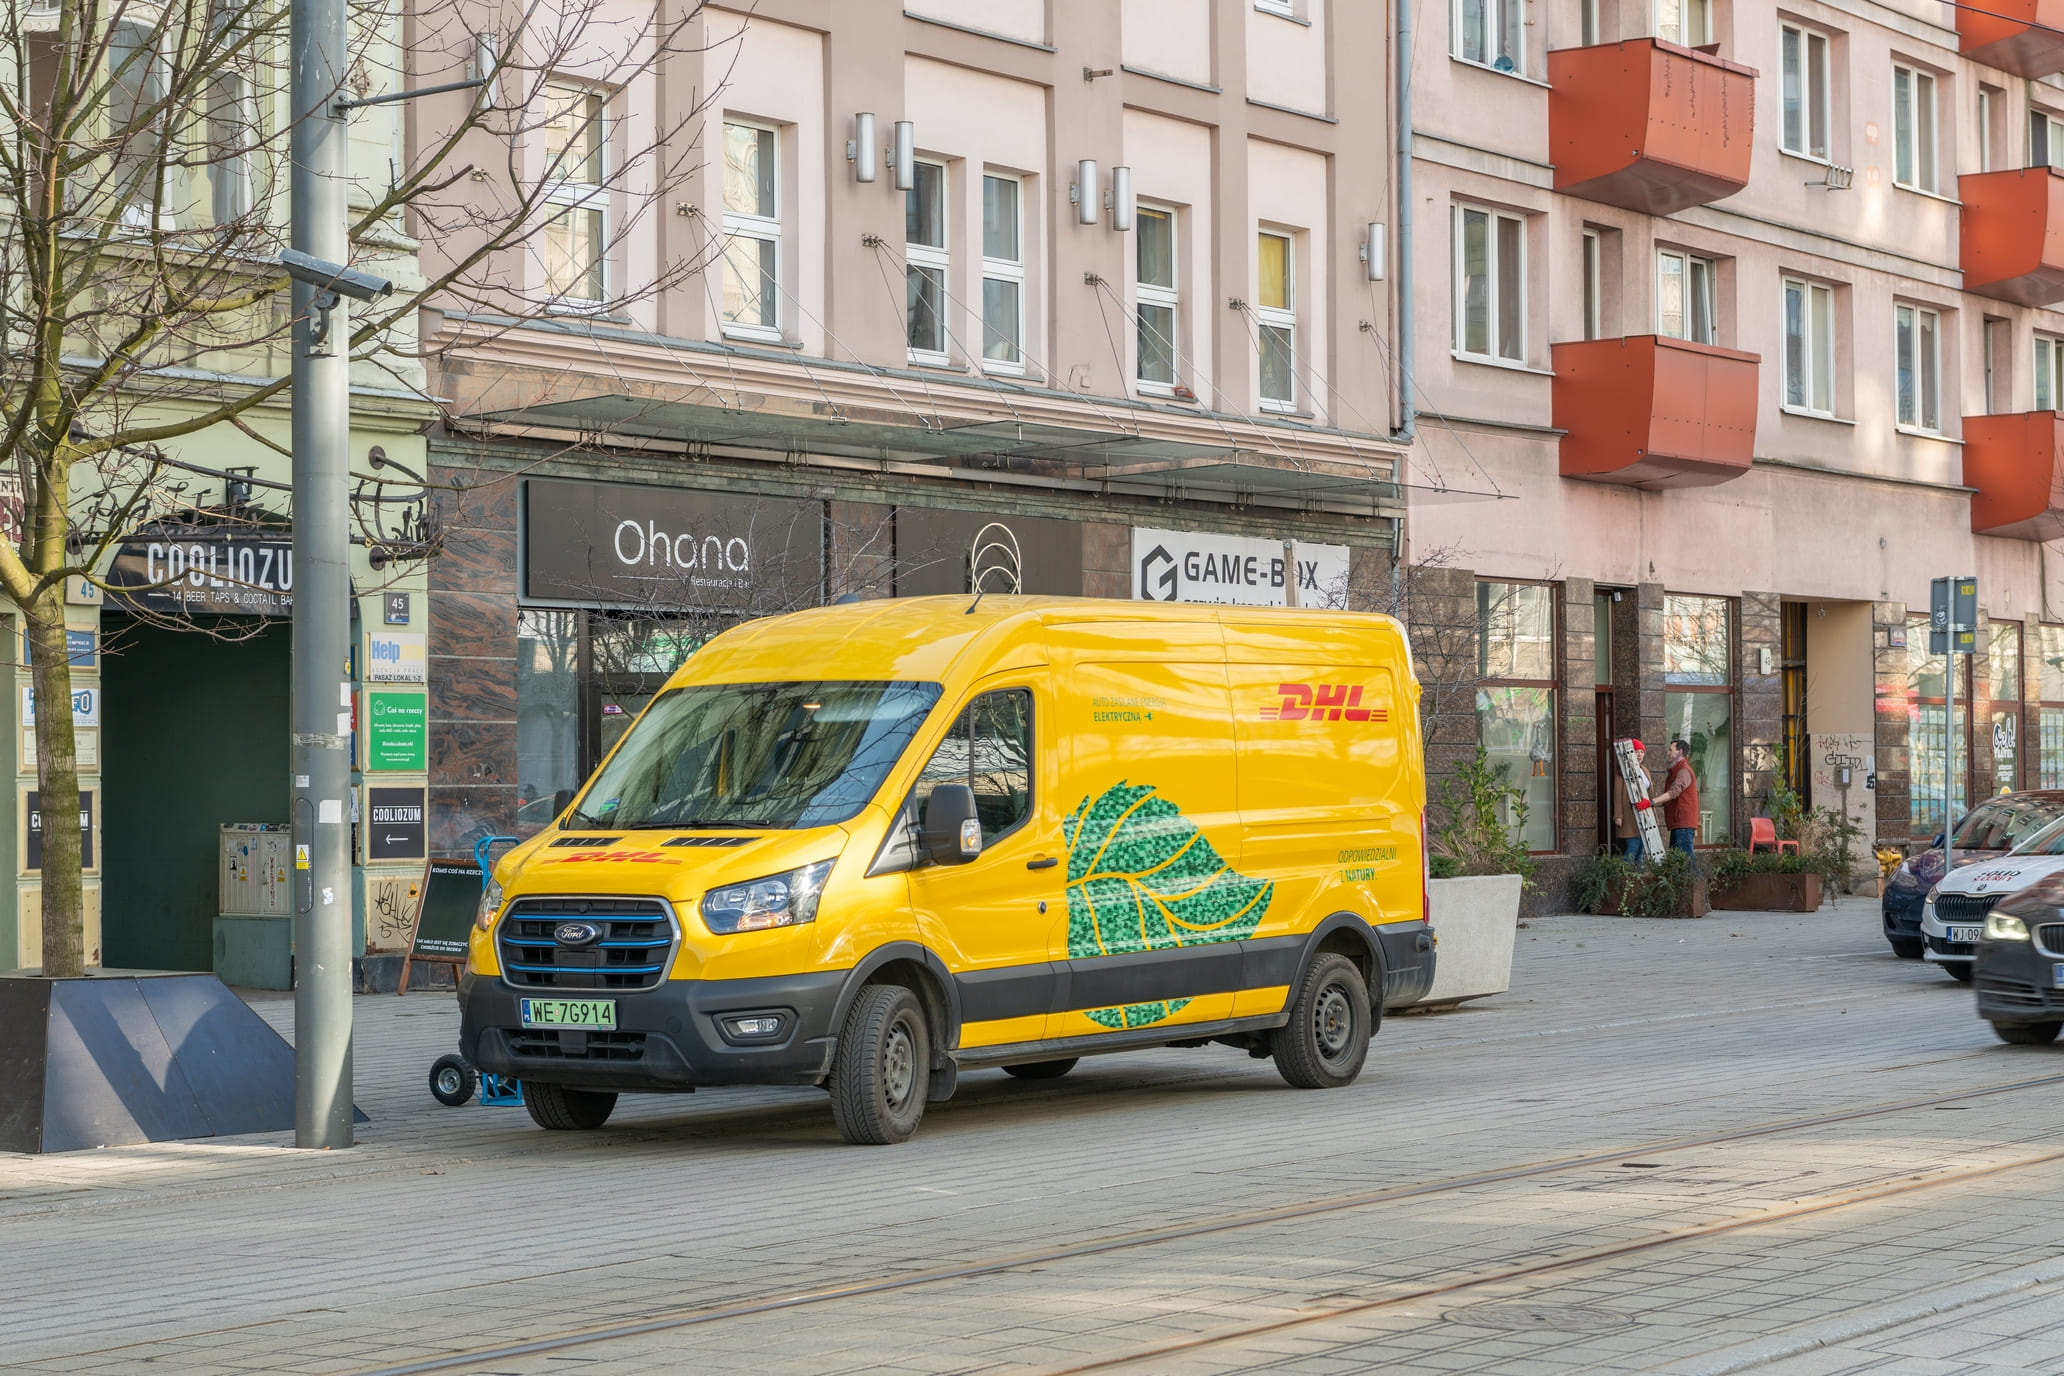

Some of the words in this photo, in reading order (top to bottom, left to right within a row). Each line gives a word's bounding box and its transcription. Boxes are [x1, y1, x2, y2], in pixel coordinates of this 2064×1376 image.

[614, 519, 749, 571] Ohana
[147, 542, 293, 591] COOLIOZU
[1184, 551, 1319, 590] GAME-BX
[80, 581, 95, 598] 45
[690, 576, 732, 588] Restauracja
[172, 591, 182, 601] 14
[186, 591, 206, 602] BEER
[210, 591, 230, 603] TAPS
[233, 592, 240, 604] &
[243, 593, 277, 605] COCTAIL
[391, 598, 404, 609] 45
[1278, 683, 1372, 721] DHL
[372, 808, 421, 822] COOLIOZUM
[561, 851, 669, 863] DHL
[1337, 847, 1397, 864] ODPOWIEDZIALNI
[561, 927, 585, 939] Ford
[1952, 928, 1965, 940] WJ
[532, 1002, 555, 1023] WE
[559, 1003, 612, 1024] 7G914
